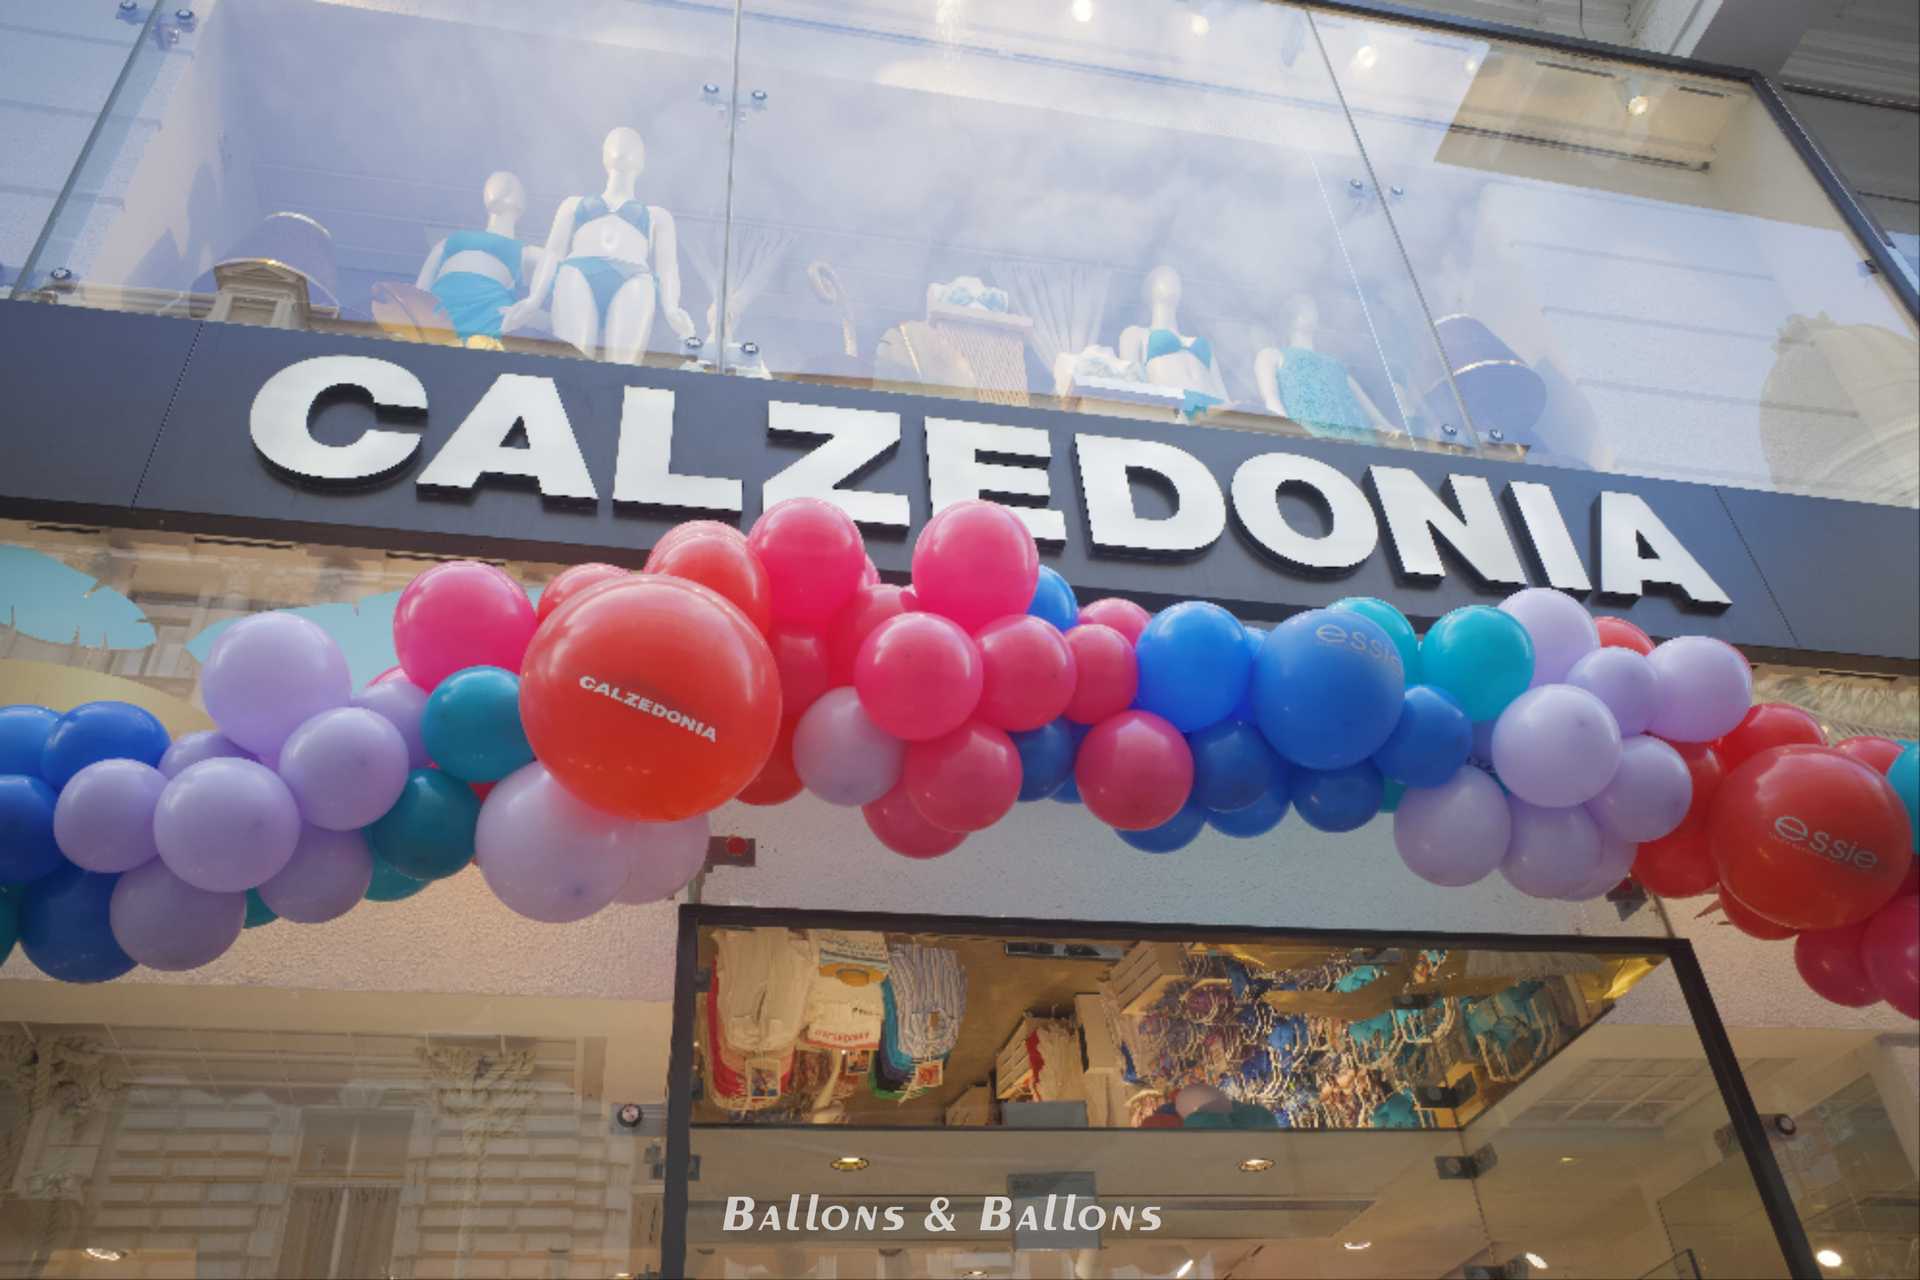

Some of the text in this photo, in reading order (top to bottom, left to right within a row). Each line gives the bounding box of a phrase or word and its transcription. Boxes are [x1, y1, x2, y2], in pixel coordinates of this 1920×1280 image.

[250, 354, 1732, 605] CALZEDONIA
[579, 675, 717, 743] CALZEDONIA
[1775, 815, 1878, 868] essie
